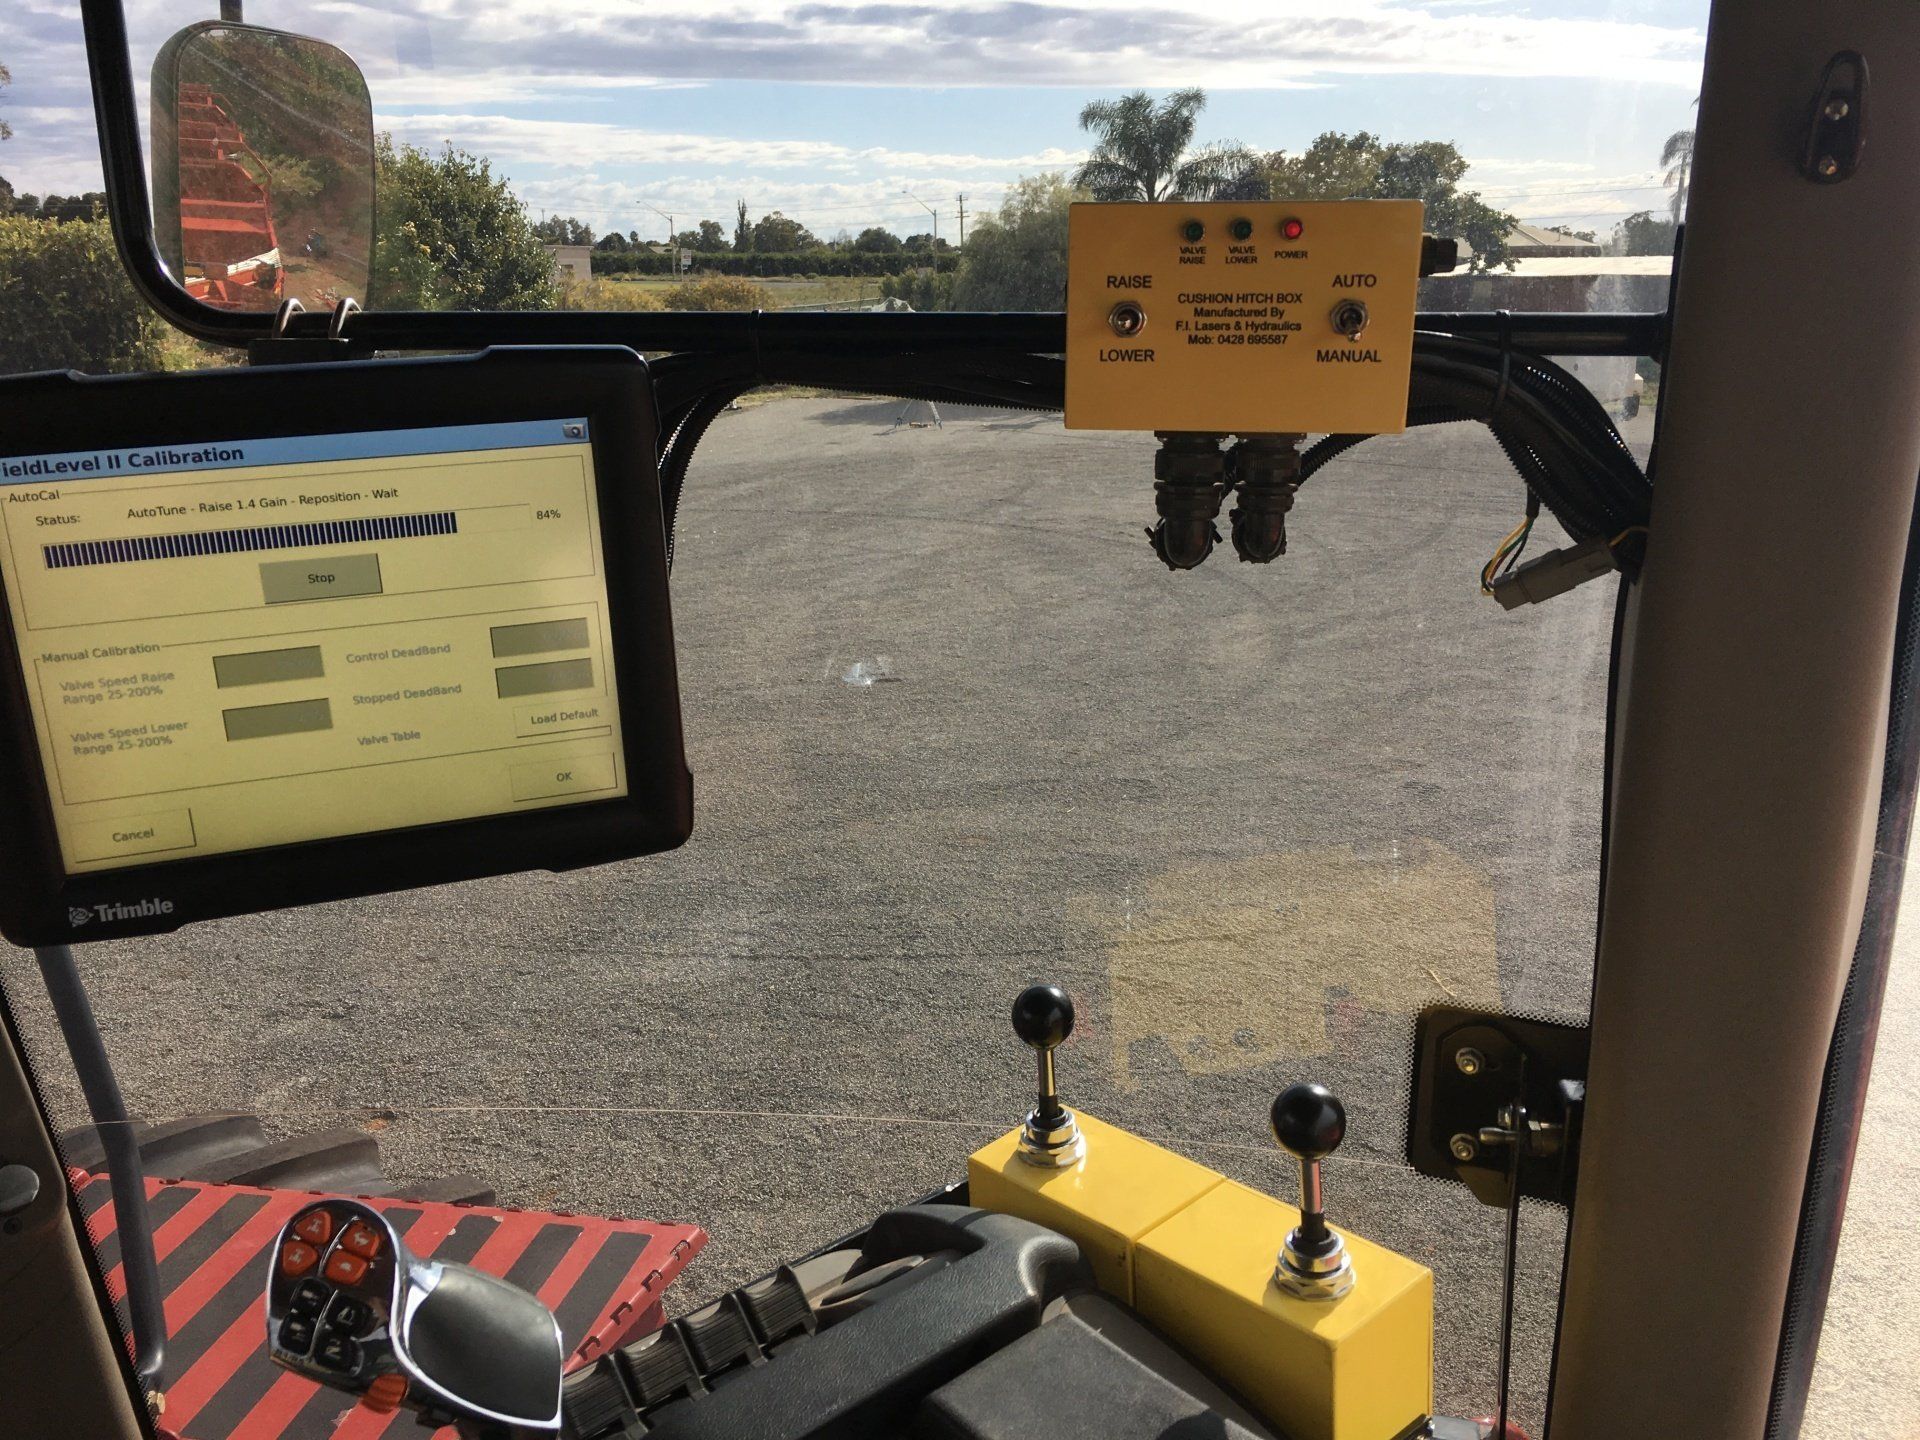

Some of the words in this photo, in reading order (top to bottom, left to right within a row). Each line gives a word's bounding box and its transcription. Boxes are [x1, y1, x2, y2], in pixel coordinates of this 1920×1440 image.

[1180, 246, 1206, 254] VALVE
[1228, 246, 1255, 254] VALVE
[1274, 250, 1308, 260] POWER
[1179, 256, 1205, 265] RAISE
[1225, 255, 1257, 265] LOWER
[1106, 275, 1152, 289] RAISE
[1332, 274, 1377, 288] AUTO
[1177, 293, 1233, 304] CUSHION
[1236, 293, 1274, 304] HITCH
[1276, 293, 1303, 304] BOX
[1193, 307, 1268, 318] Manufactured
[1270, 307, 1285, 319] By
[1195, 320, 1231, 331] Lasers
[1234, 321, 1242, 331] &
[1245, 320, 1302, 333] Hydraulics
[1187, 334, 1214, 345] Mob:
[1217, 334, 1245, 345] 0428
[1099, 348, 1155, 363] LOWER
[1316, 350, 1382, 363] MANUAL
[2, 454, 100, 477] ieldLevel
[107, 454, 121, 469] II
[127, 447, 244, 468] Calibration
[8, 489, 60, 504] AutoCal
[127, 505, 186, 519] AutoTune
[198, 500, 232, 514] Raise
[236, 499, 256, 510] 1.4
[259, 497, 287, 509] Gain
[299, 490, 361, 506] Reposition
[372, 487, 399, 500] Wait
[35, 513, 81, 527] Status:
[536, 508, 561, 521] 84%
[307, 572, 336, 585] Stop
[42, 650, 89, 663] Manual
[92, 644, 160, 659] Calibration
[346, 651, 389, 664] Control
[391, 643, 452, 659] DeadBand
[60, 680, 95, 692] Valve
[98, 674, 138, 689] Speed
[141, 671, 175, 683] Raise
[63, 692, 103, 705] Range
[108, 686, 163, 700] 25-200%
[352, 690, 400, 706] Stopped
[403, 684, 462, 699] DeadBand
[530, 713, 557, 726] Load
[560, 707, 599, 722] Default
[70, 732, 105, 744] Valve
[108, 724, 147, 740] Speed
[150, 721, 189, 734] Lower
[357, 735, 389, 747] Valve
[391, 729, 421, 742] Table
[73, 743, 113, 756] Range
[117, 736, 172, 751] 25-200%
[556, 771, 572, 783] OK
[112, 828, 154, 842] Cancel
[93, 898, 174, 922] Trimble
